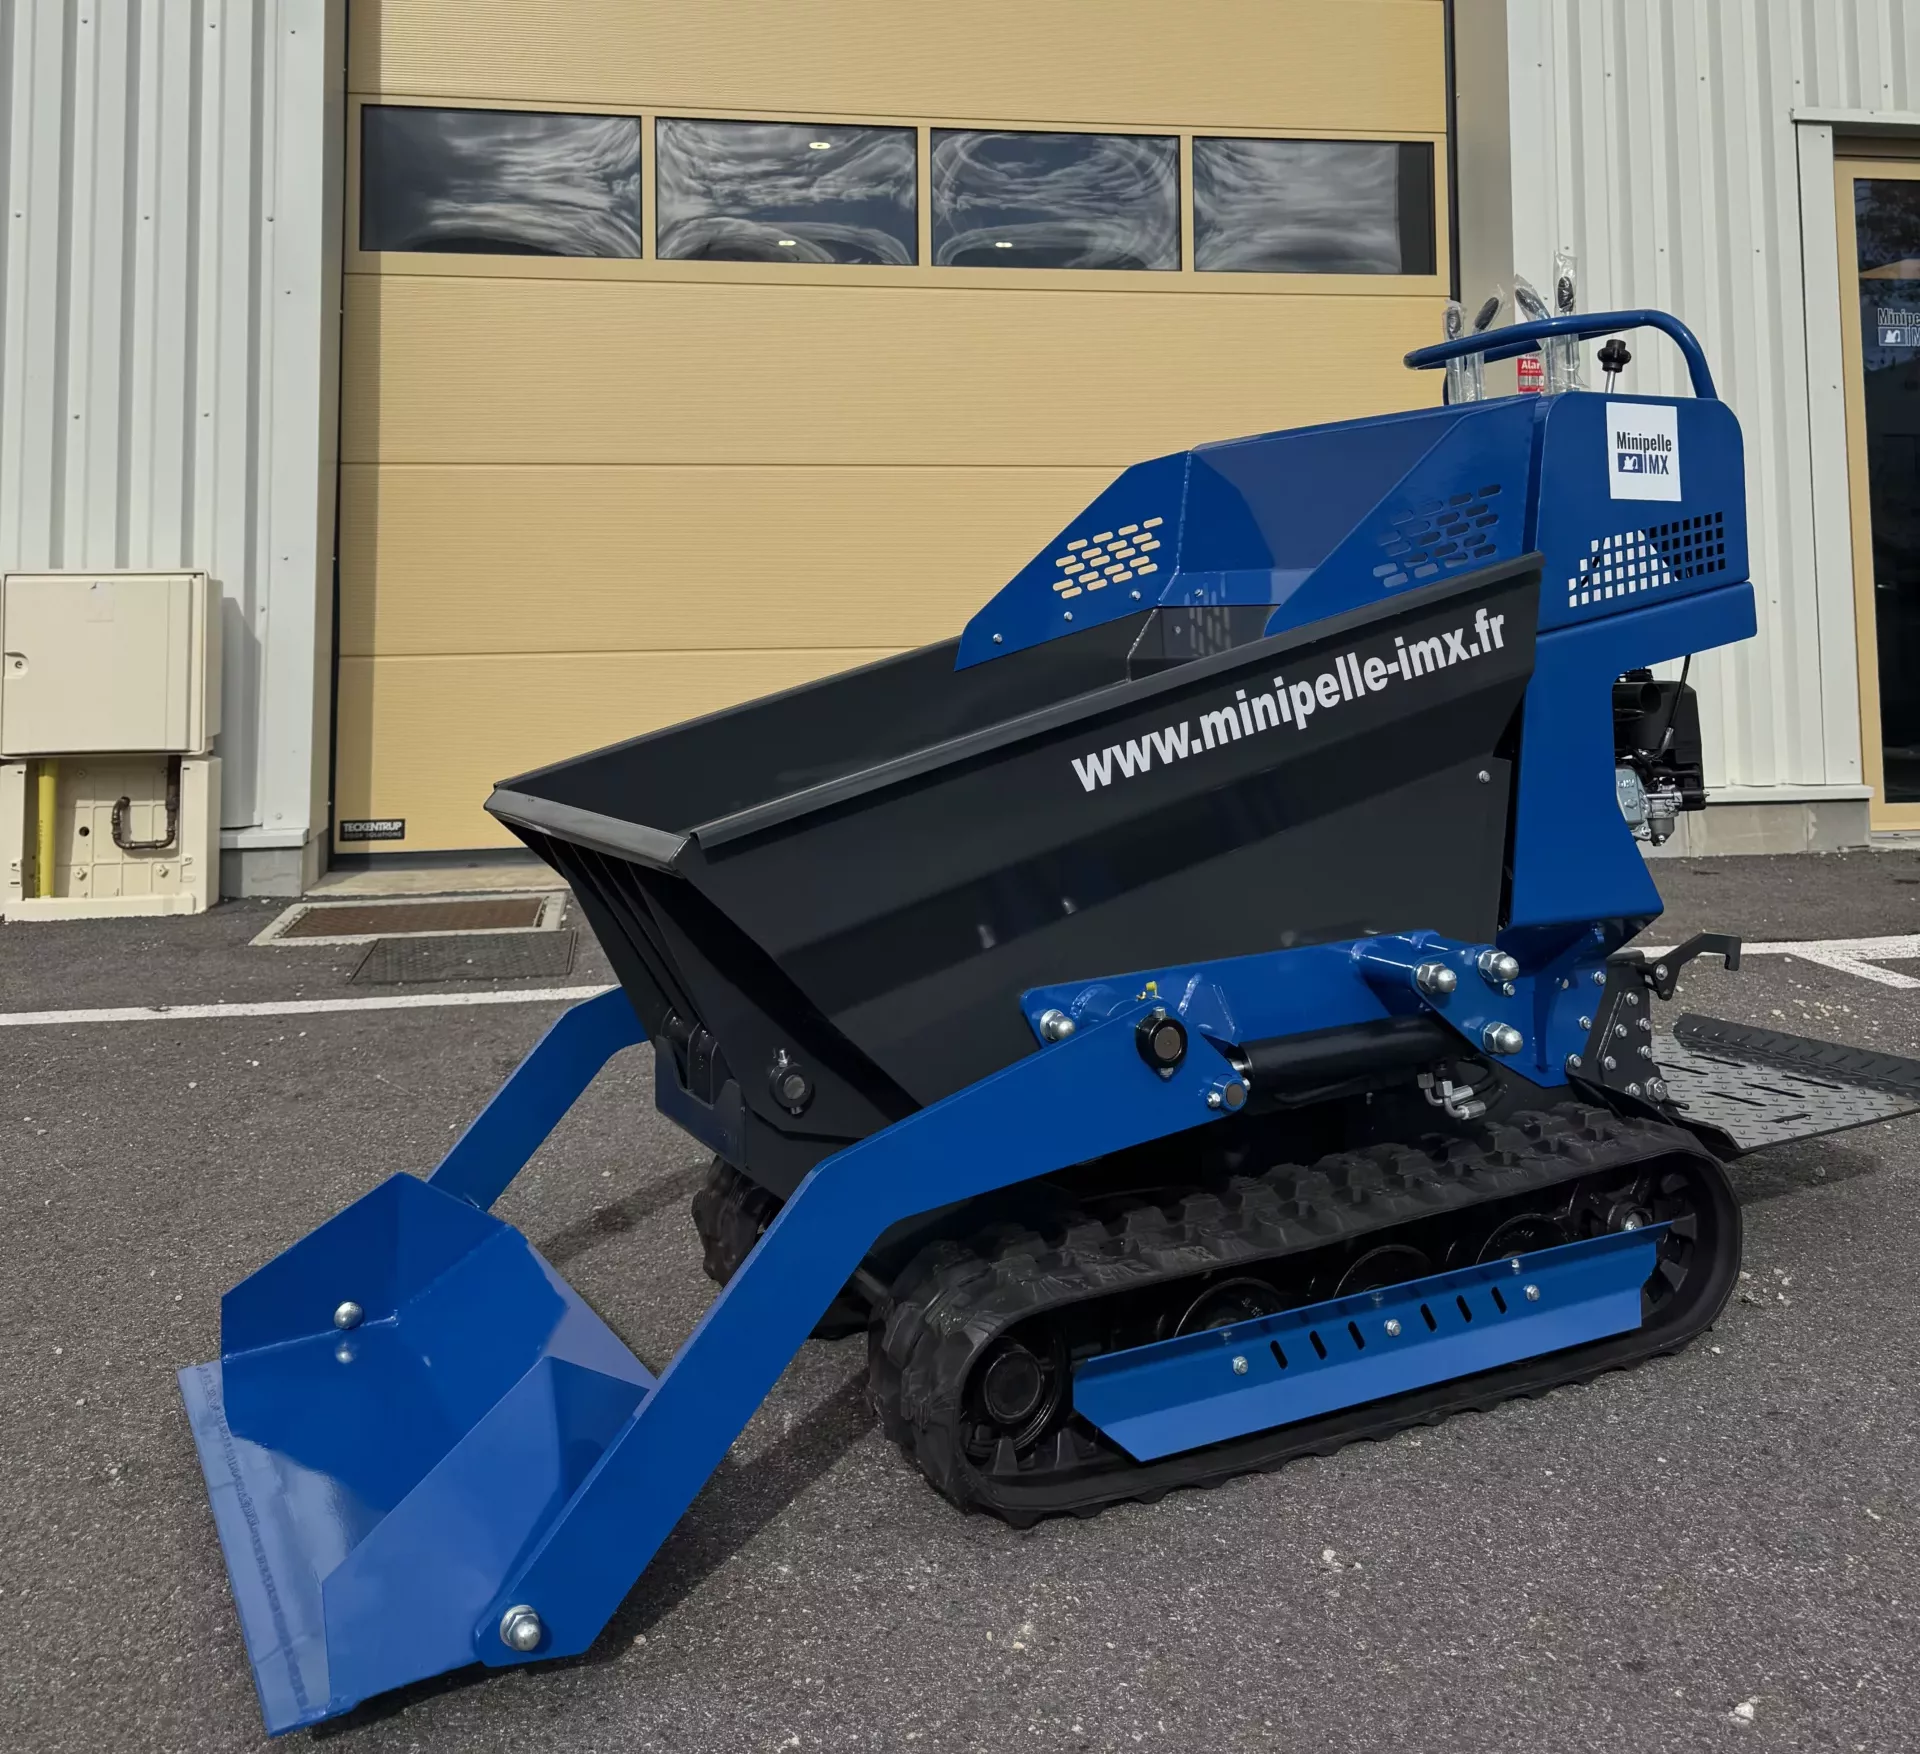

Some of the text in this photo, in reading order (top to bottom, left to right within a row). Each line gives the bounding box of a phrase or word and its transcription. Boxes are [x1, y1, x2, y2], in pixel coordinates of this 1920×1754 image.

[1616, 431, 1672, 453] Minipelle
[1643, 453, 1669, 475] IMX
[1071, 608, 1505, 792] www.minipelle-imx.fr
[343, 821, 403, 833] TECKENTRUP
